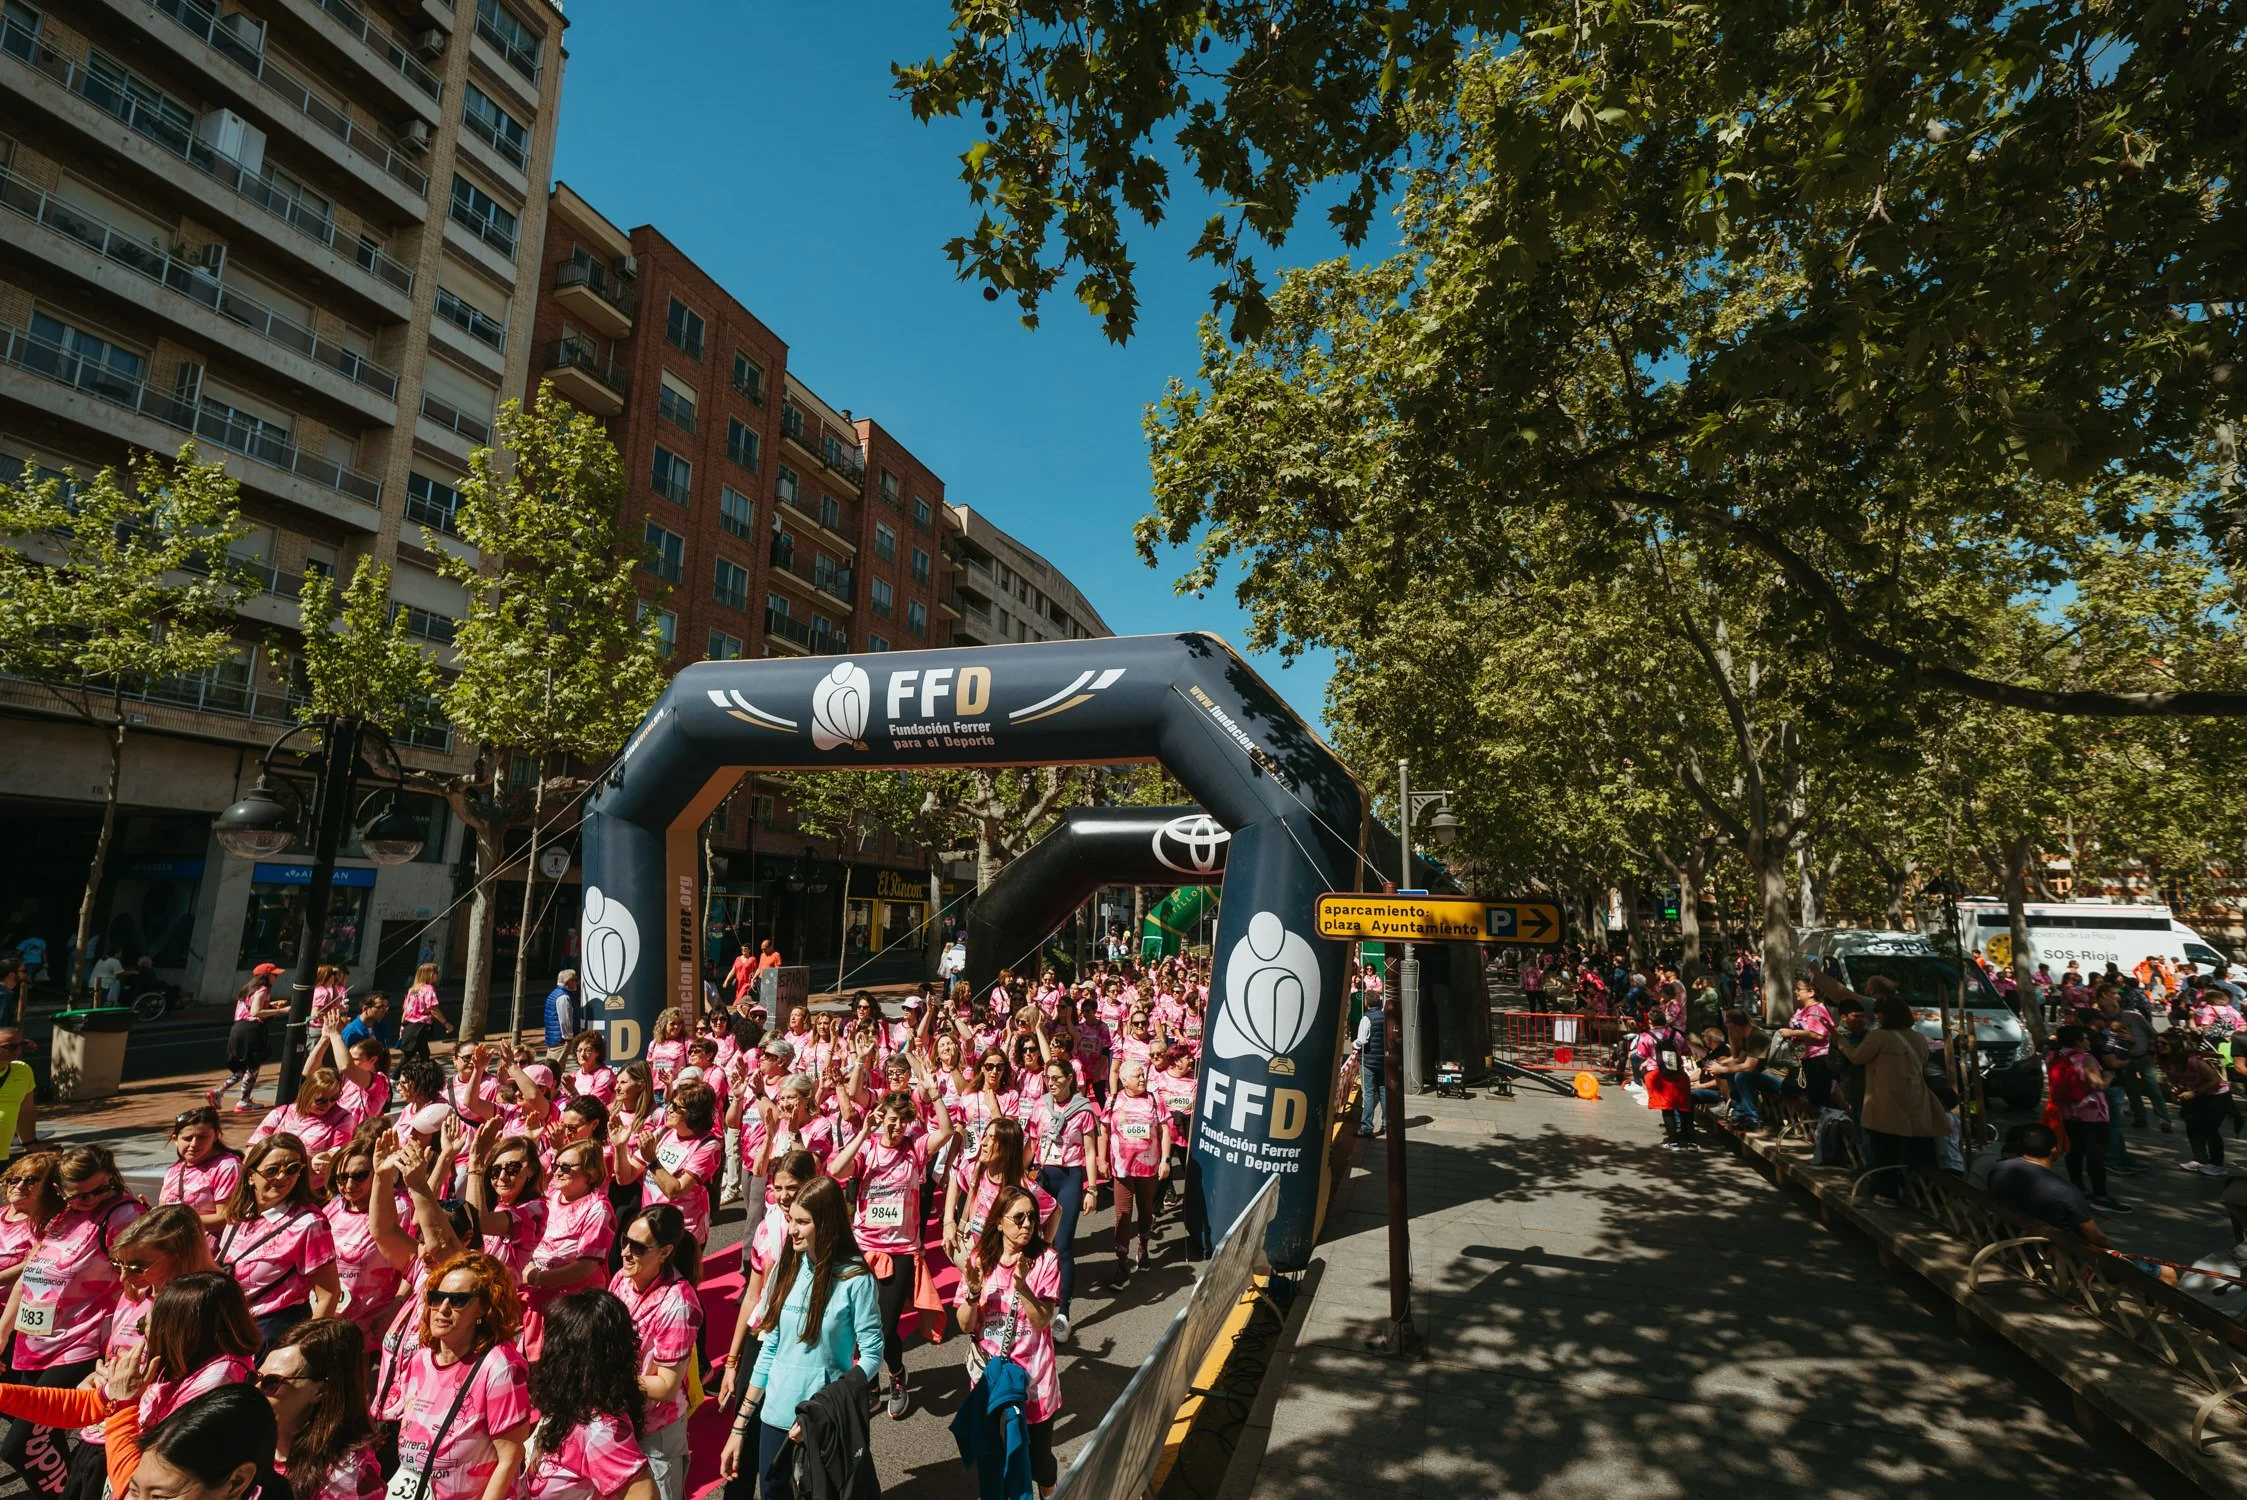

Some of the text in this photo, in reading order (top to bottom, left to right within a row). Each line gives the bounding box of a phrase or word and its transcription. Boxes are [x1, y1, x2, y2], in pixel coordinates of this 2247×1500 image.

[887, 666, 991, 719] FFD
[889, 721, 991, 736] Fundación Ferrer
[893, 735, 996, 751] para el Deporte
[877, 871, 923, 898] El Rincón
[1324, 904, 1430, 918] aparcamiento:
[1324, 920, 1479, 935] plaza Ayuntamiento
[1491, 910, 1512, 935] P
[2092, 932, 2116, 941] Rioja
[2043, 949, 2119, 962] SOS-Rioja
[1203, 1067, 1308, 1140] FFD
[1126, 1125, 1146, 1134] 6684
[1200, 1121, 1302, 1158] Fundación Ferrer
[1199, 1138, 1299, 1173] para el Deporte
[871, 1206, 899, 1219] 9844
[985, 1320, 996, 1328] por
